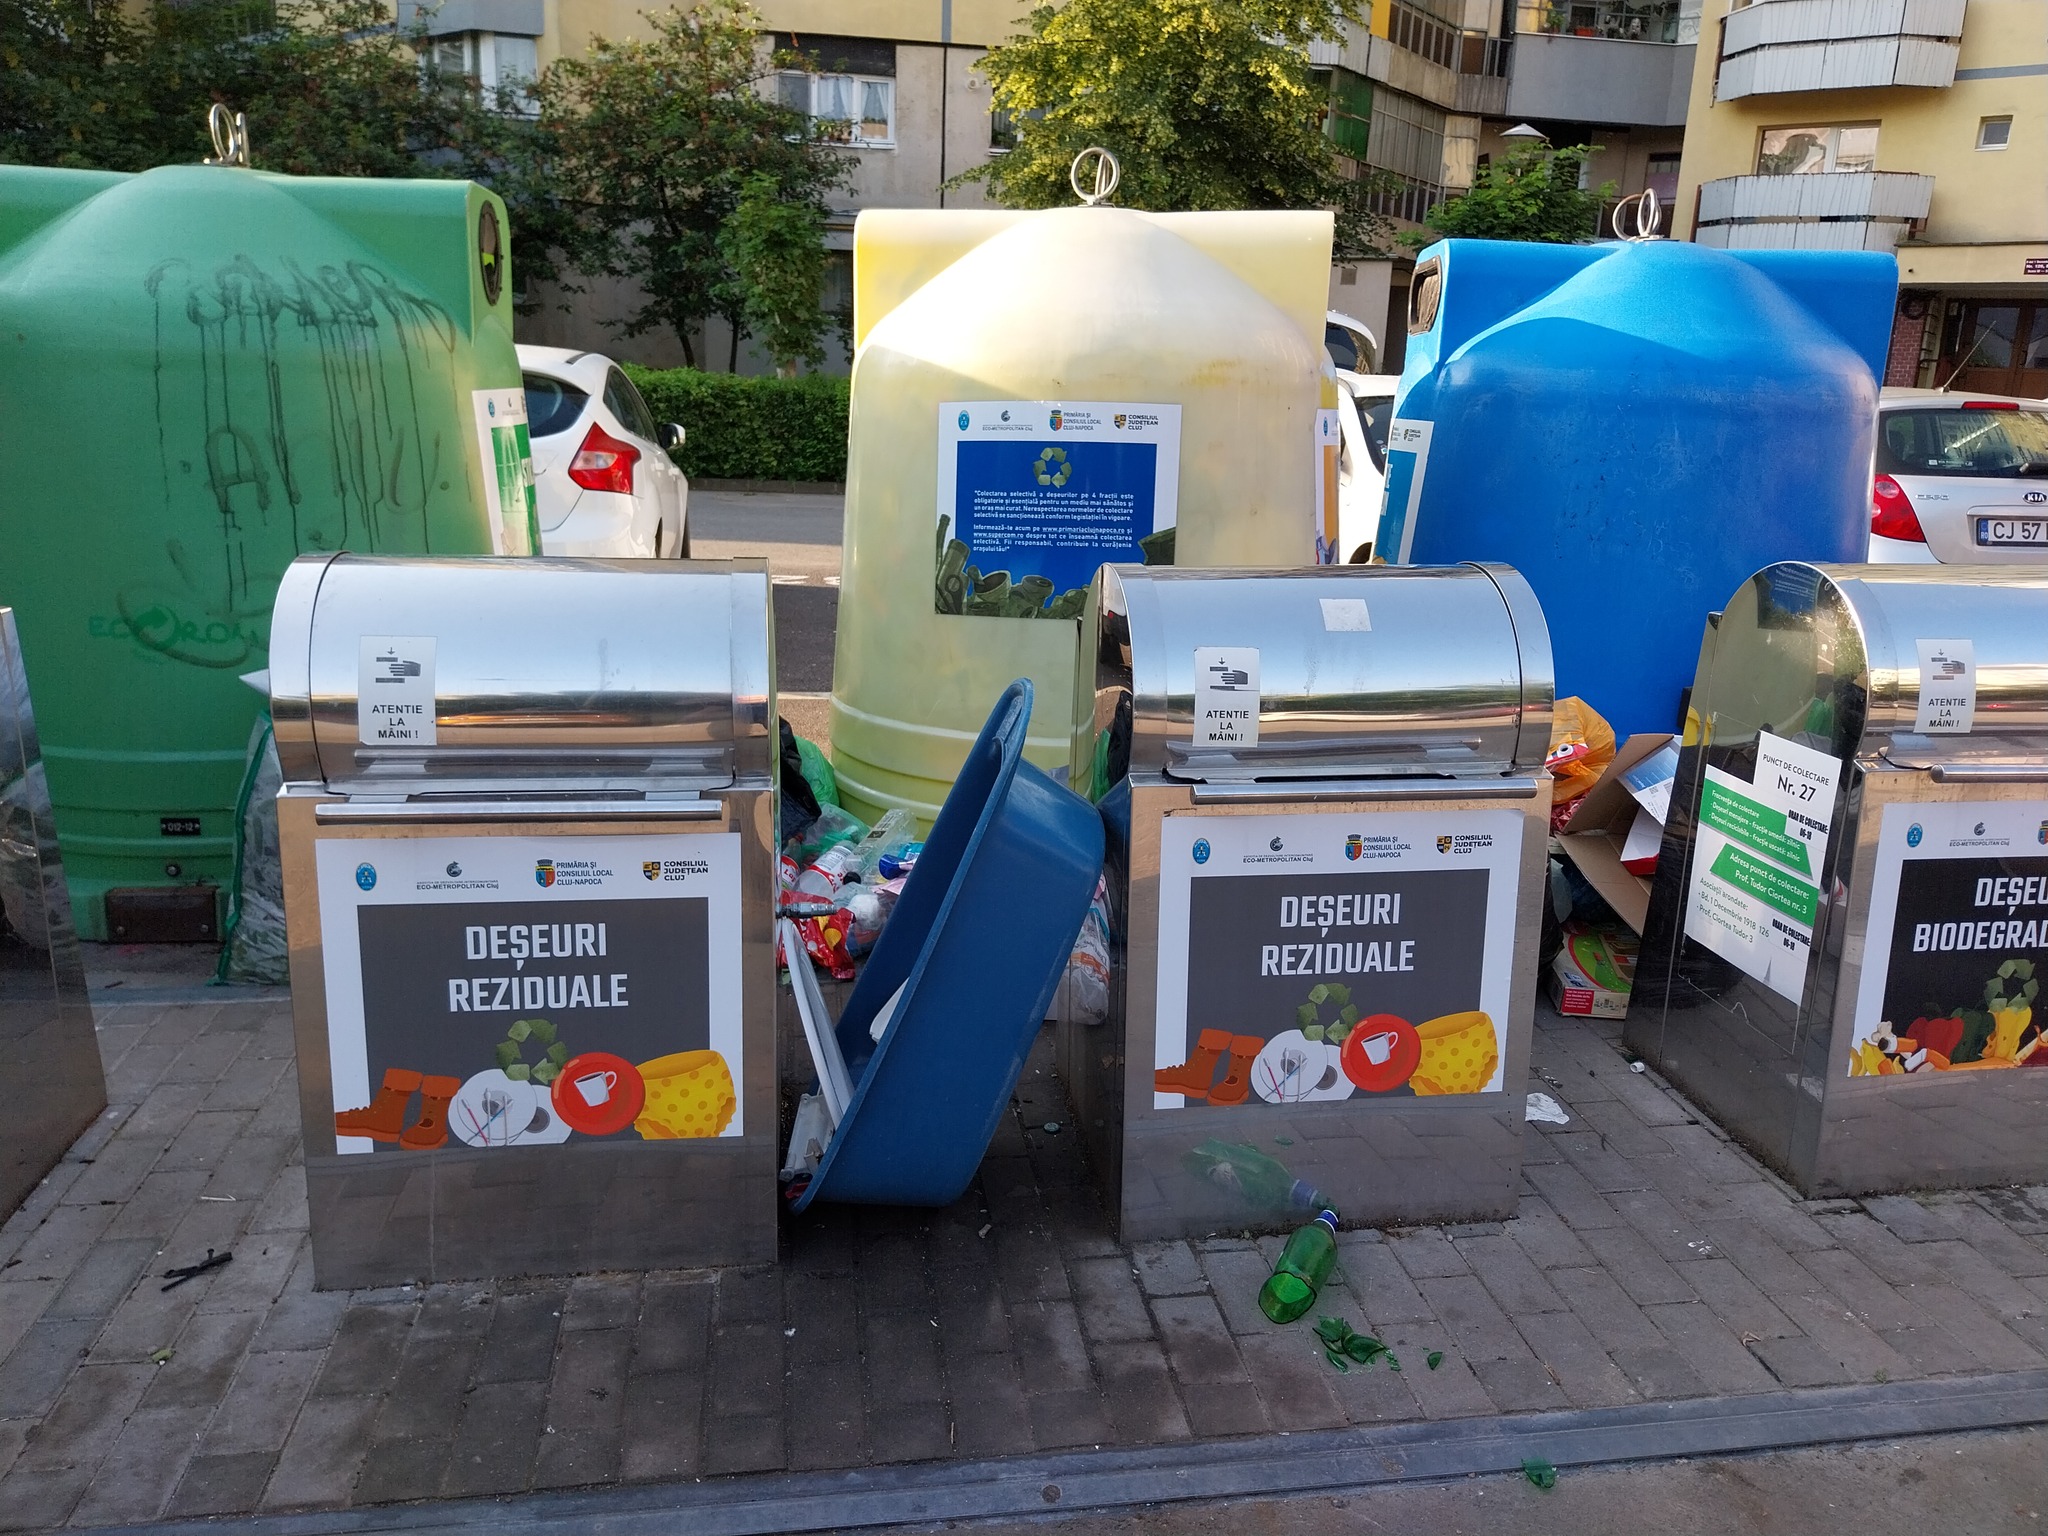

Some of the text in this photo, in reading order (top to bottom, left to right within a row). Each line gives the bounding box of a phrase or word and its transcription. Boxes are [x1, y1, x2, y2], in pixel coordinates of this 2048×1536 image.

[1994, 522, 2014, 539] CJ
[2022, 522, 2041, 540] 57
[1928, 698, 1966, 706] ATENTIE
[372, 705, 423, 714] ATENTIE
[1206, 710, 1249, 719] ATENTIE
[1940, 709, 1952, 717] LA
[390, 718, 405, 726] LA
[1220, 722, 1233, 730] LA
[1929, 717, 1954, 727] MÂINI
[1208, 731, 1237, 741] MÂINI
[1763, 754, 1829, 786] PUNCT DE COLECTARE
[1778, 774, 1816, 801] Nr. 27
[1800, 815, 1805, 824] DE
[1392, 836, 1398, 844] ȘI
[1454, 841, 1493, 849] JUDEȚEAN
[556, 860, 597, 870] PRIMĂRIA ȘI
[593, 869, 613, 877] LOCAL
[664, 867, 708, 876] JUDEȚEAN
[1730, 853, 1809, 899] Adresa punct de colectare:
[556, 878, 602, 886] CLUJ-NAPOCA
[1700, 877, 1749, 911] Asociații arondate:
[1735, 870, 1807, 914] Prof. Tudor Ciortea nr. 3
[1280, 893, 1401, 938] DEȘEURI
[1701, 891, 1709, 902] Bd.
[1714, 898, 1742, 922] Decembrie
[1744, 916, 1757, 930] 1918
[1759, 926, 1770, 938] 126
[1699, 904, 1753, 943] Prof. Ciortea Tudor 3
[1783, 925, 1788, 934] DE
[465, 923, 607, 971] DEȘEURI
[1261, 940, 1415, 976] REZIDUALE
[449, 974, 629, 1013] REZIDUALE
